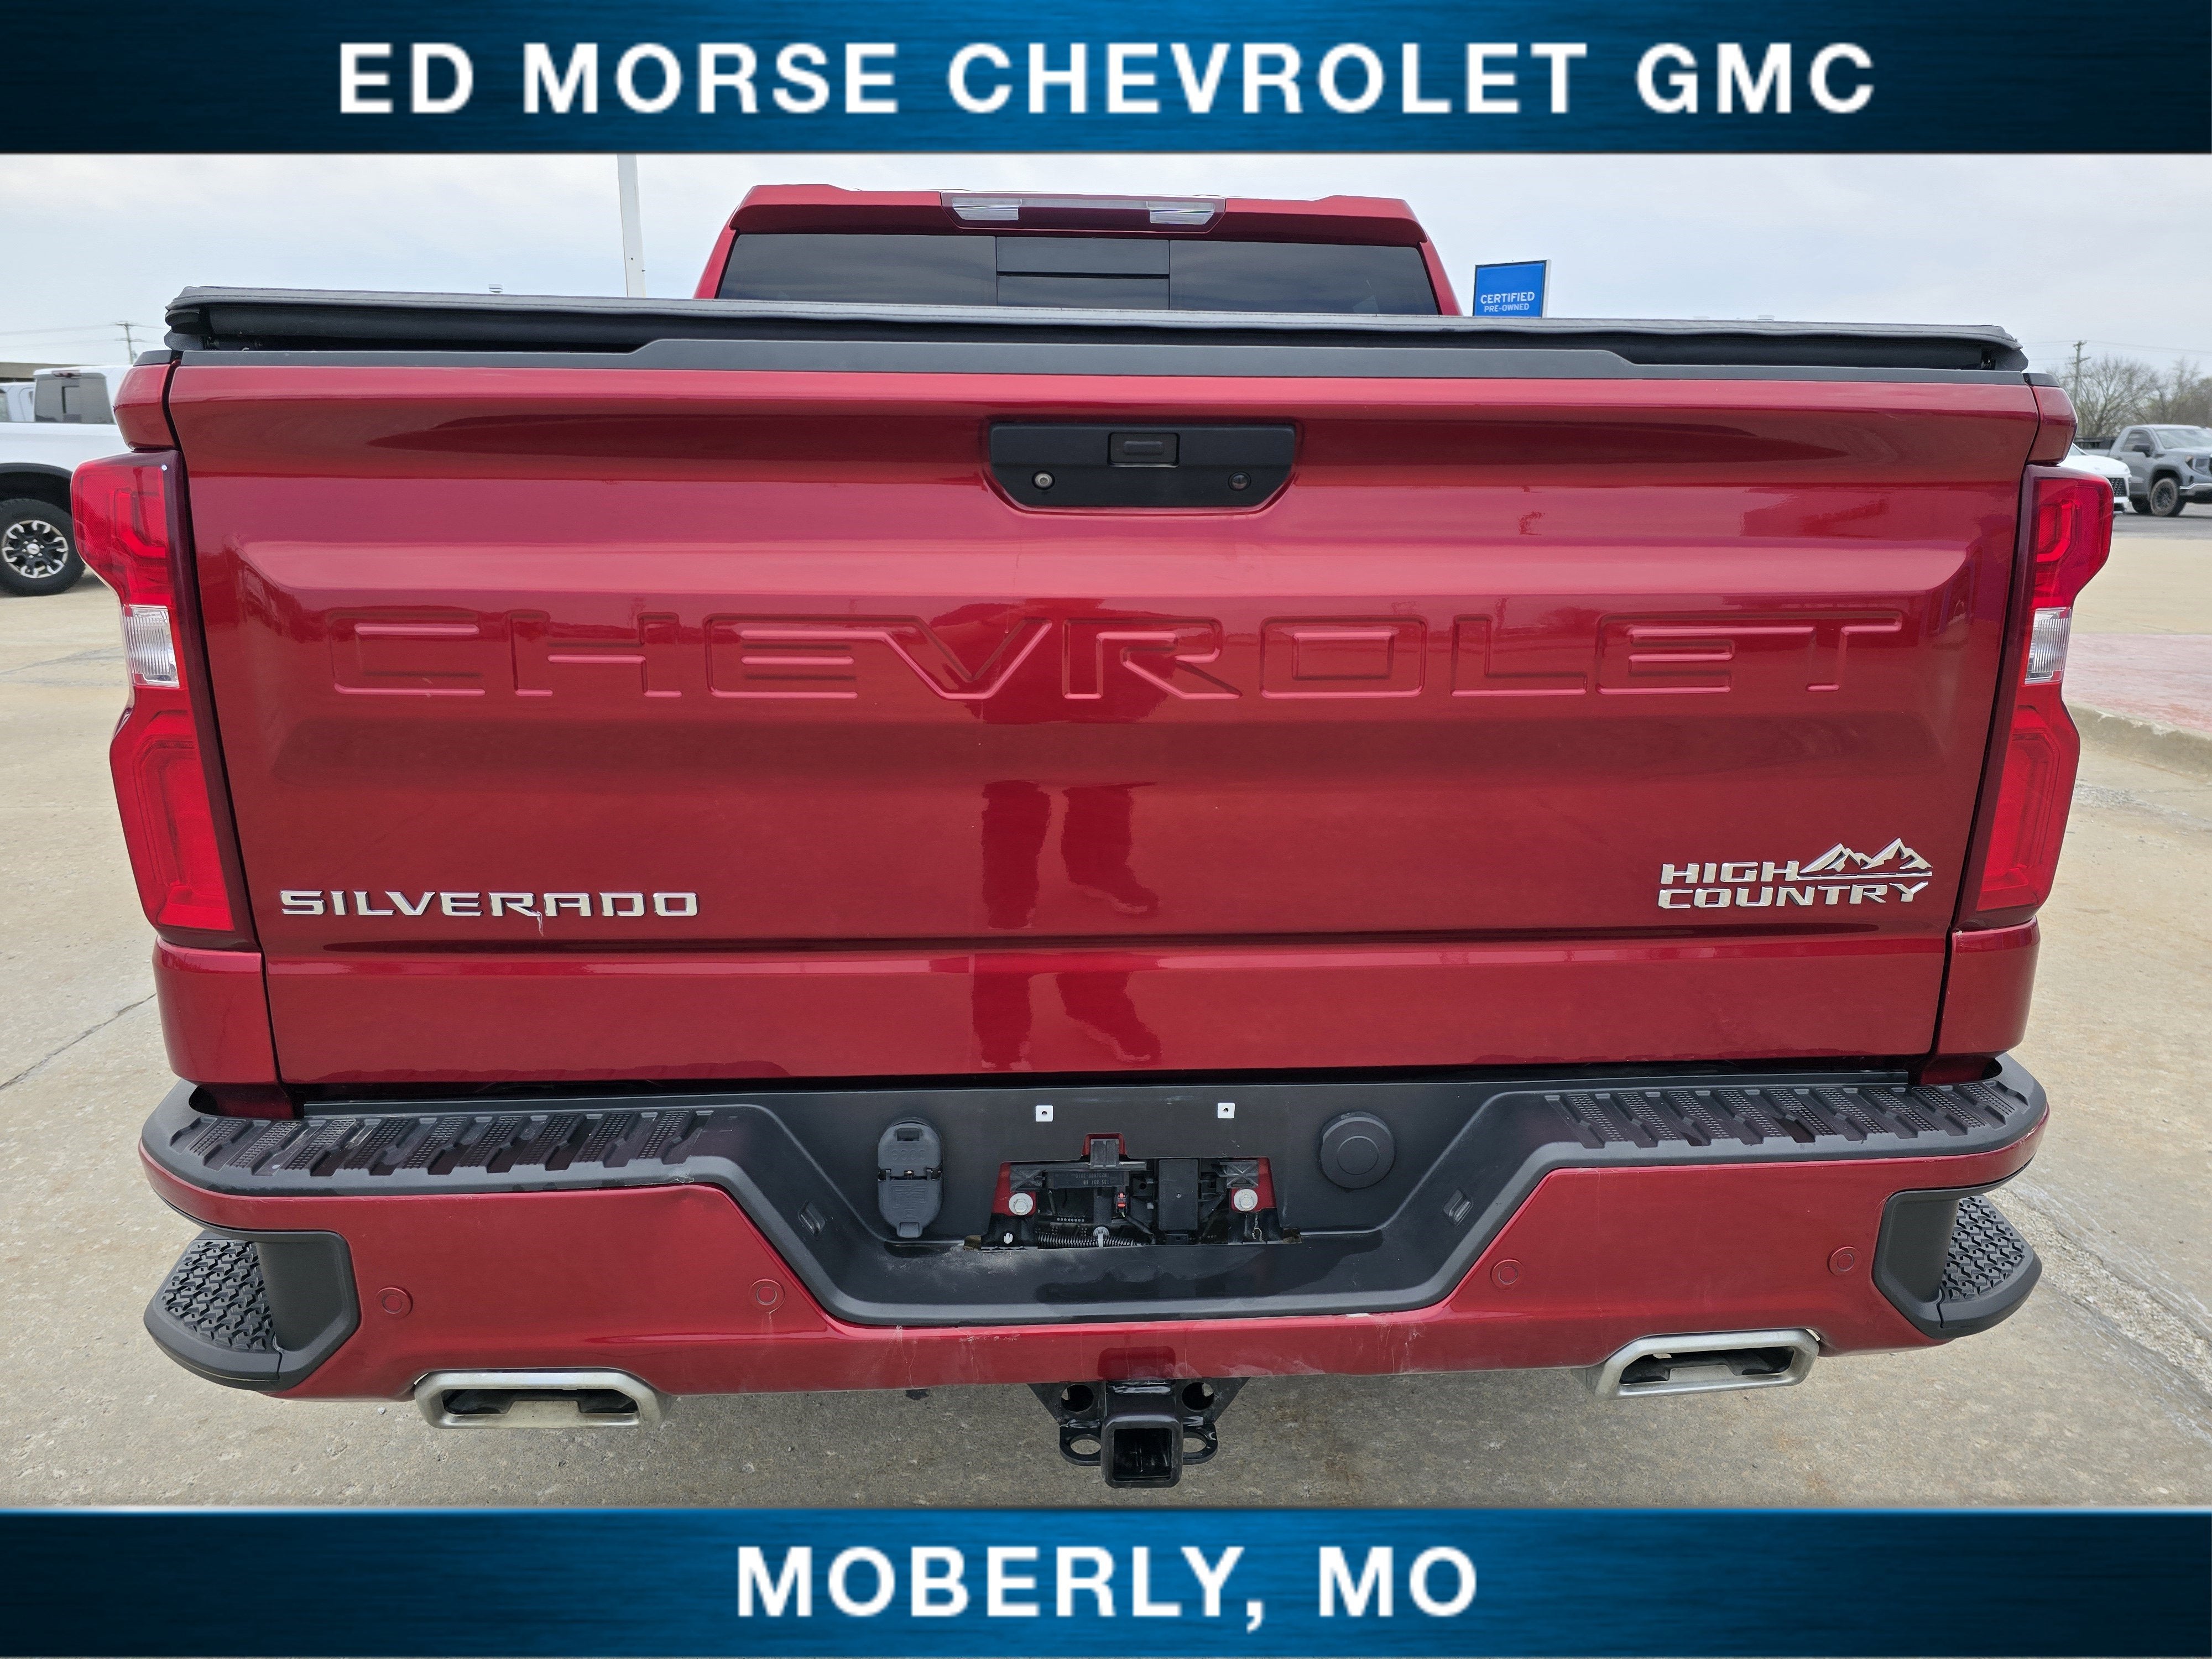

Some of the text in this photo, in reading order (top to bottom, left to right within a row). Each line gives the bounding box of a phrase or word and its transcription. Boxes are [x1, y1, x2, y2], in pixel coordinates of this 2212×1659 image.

[1480, 291, 1535, 304] CERTIFIED
[1484, 303, 1530, 312] PRE-OWNED
[327, 609, 1902, 700] CHEVROLET
[1660, 860, 1799, 884] HIGH
[280, 889, 699, 917] SILVERADO
[1657, 881, 1929, 909] COUNTRY
